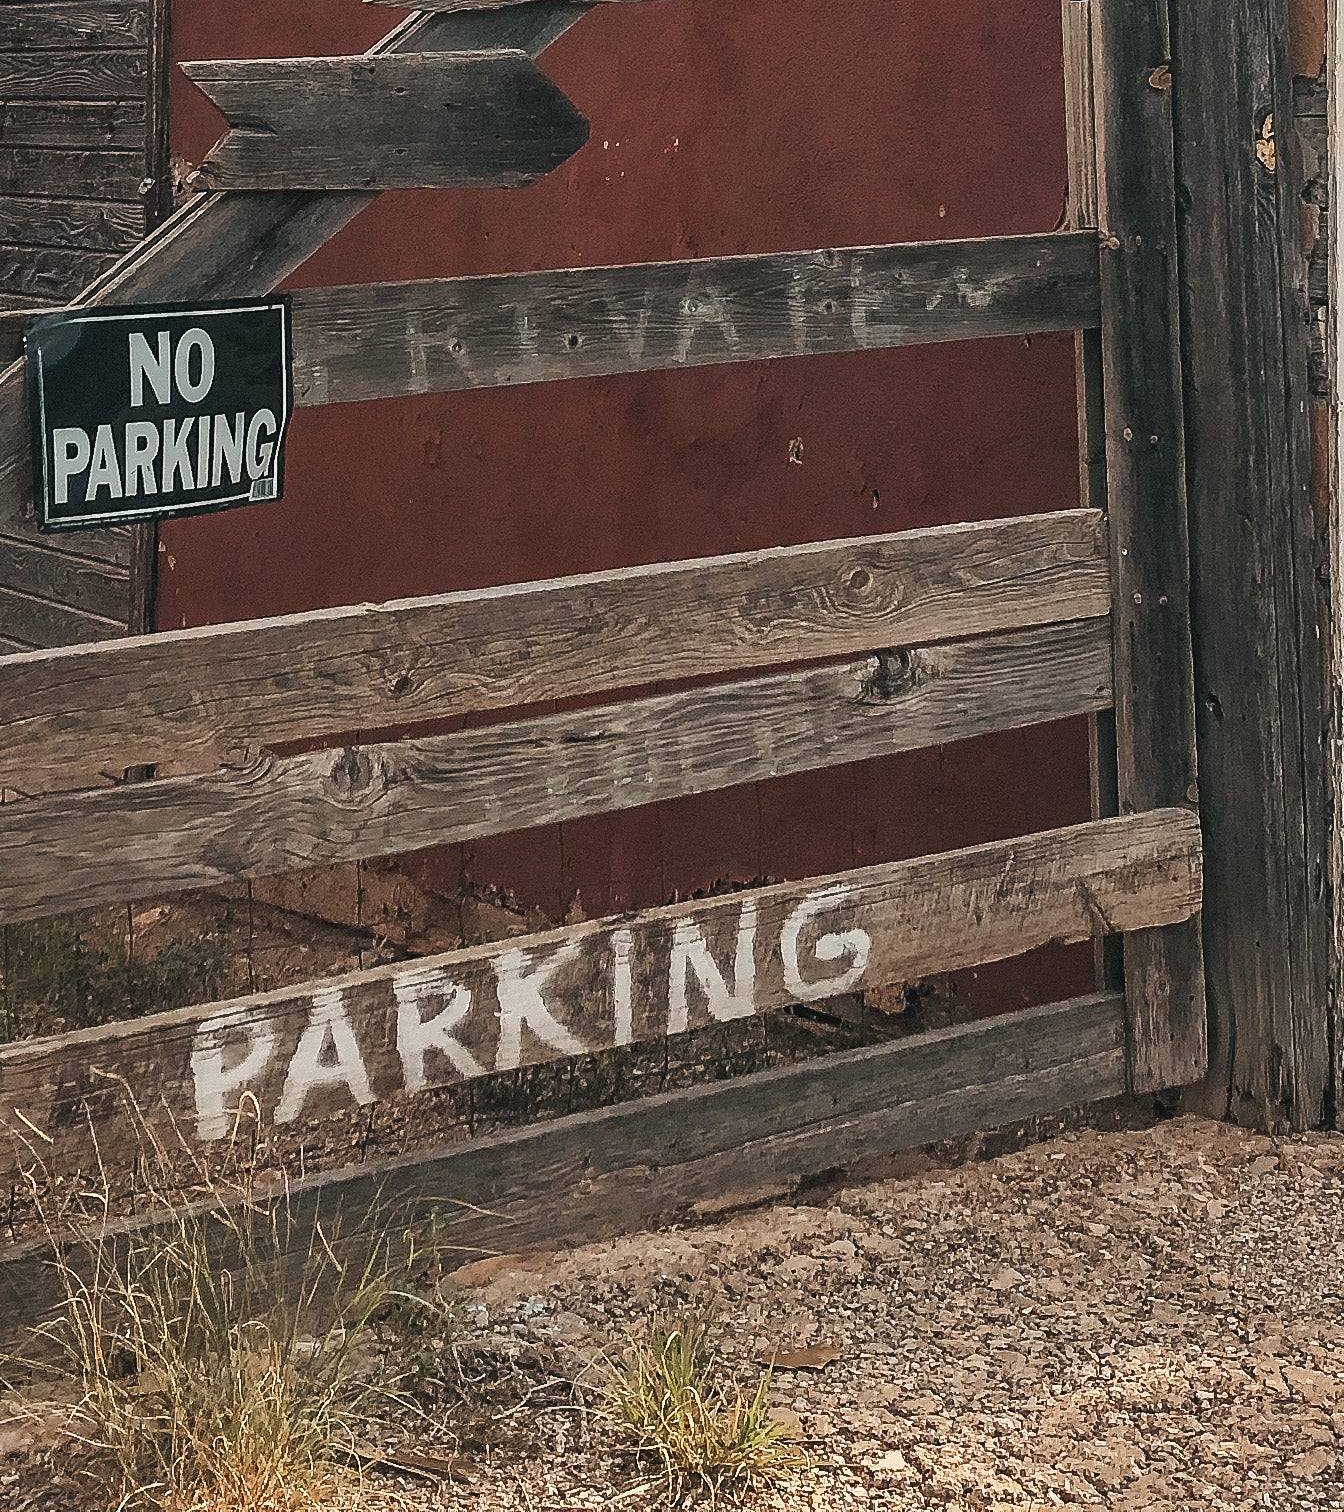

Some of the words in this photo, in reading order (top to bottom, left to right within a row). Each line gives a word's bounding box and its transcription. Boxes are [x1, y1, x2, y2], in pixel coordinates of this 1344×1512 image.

[128, 327, 215, 407] NO
[53, 408, 277, 505] PARKING
[191, 883, 871, 1141] PARKING
